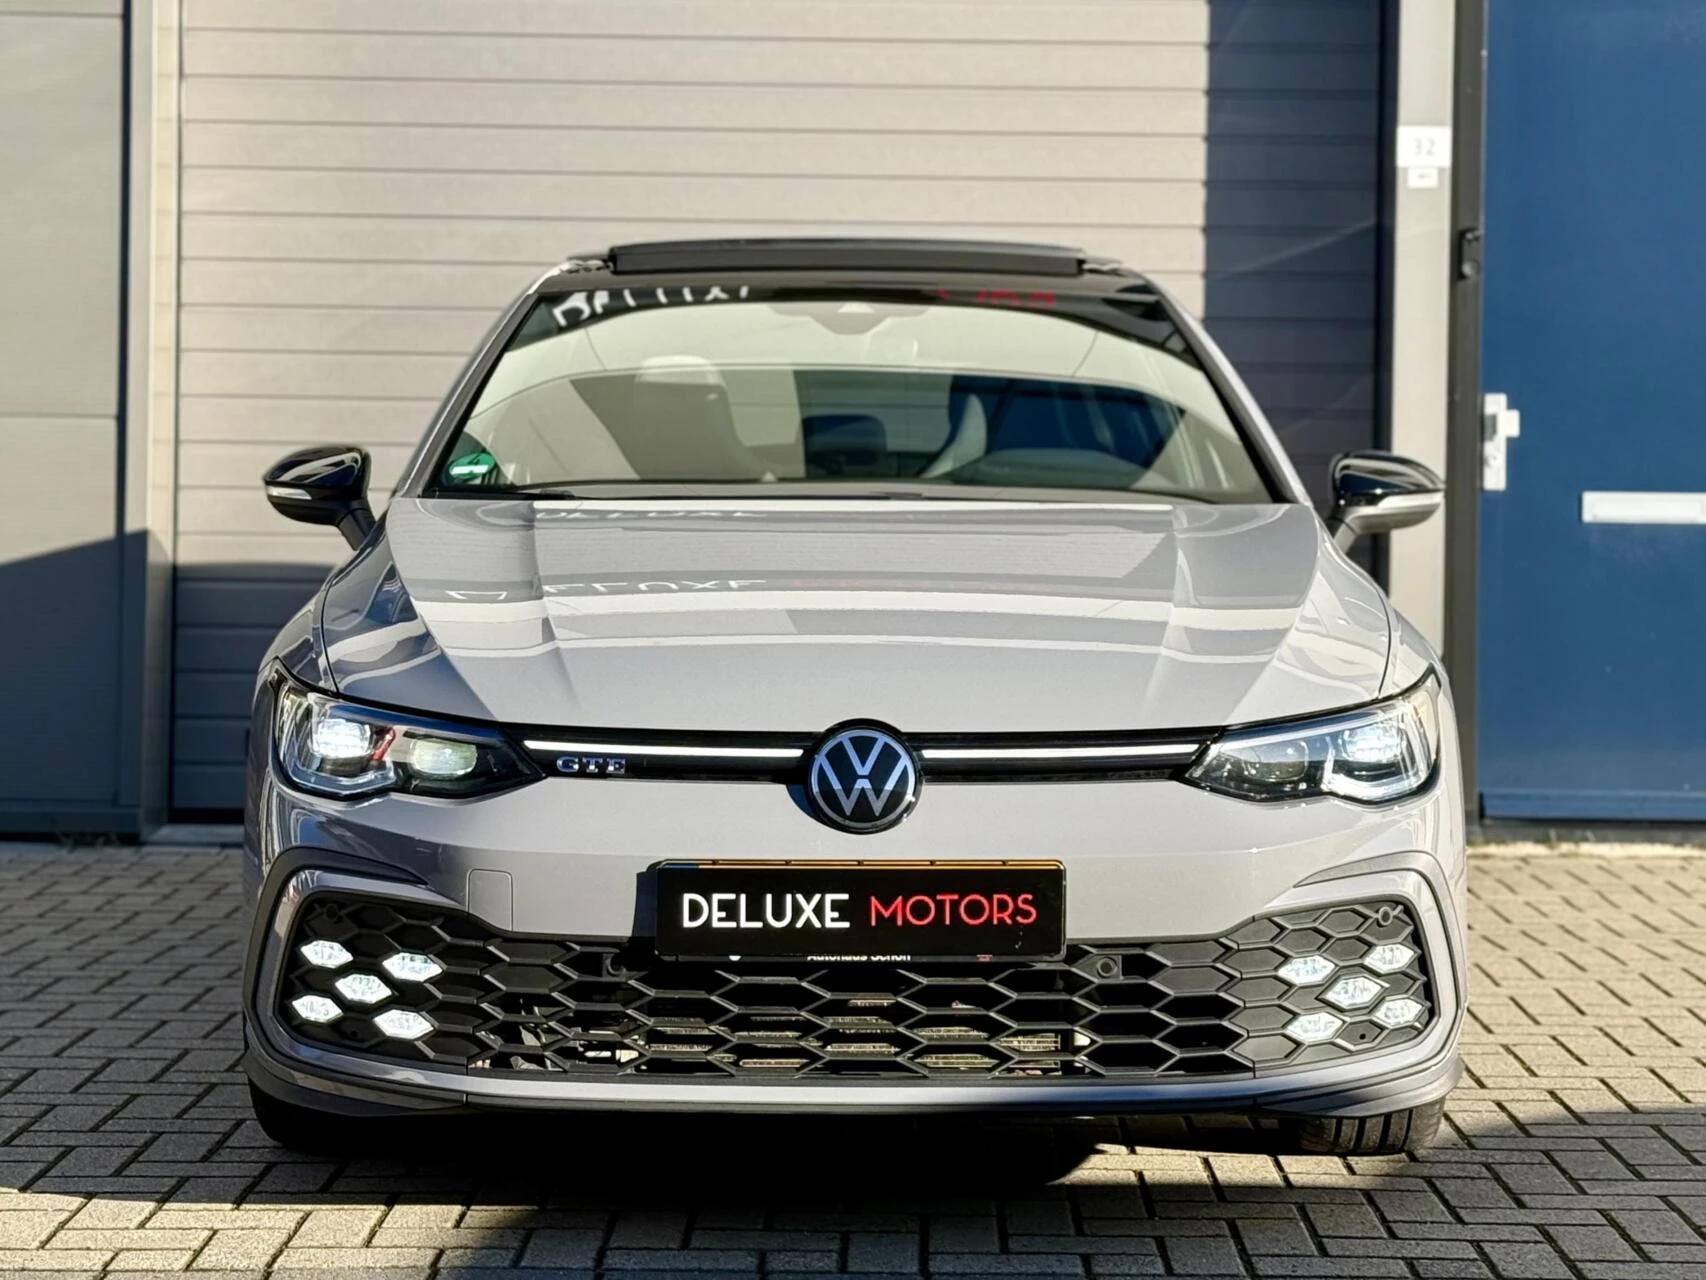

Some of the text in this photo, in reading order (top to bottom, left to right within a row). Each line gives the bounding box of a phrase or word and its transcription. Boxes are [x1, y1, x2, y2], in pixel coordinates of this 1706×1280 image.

[1413, 137, 1436, 157] 32
[556, 756, 626, 774] GTE
[682, 893, 1037, 929] DELUXE MOTORS
